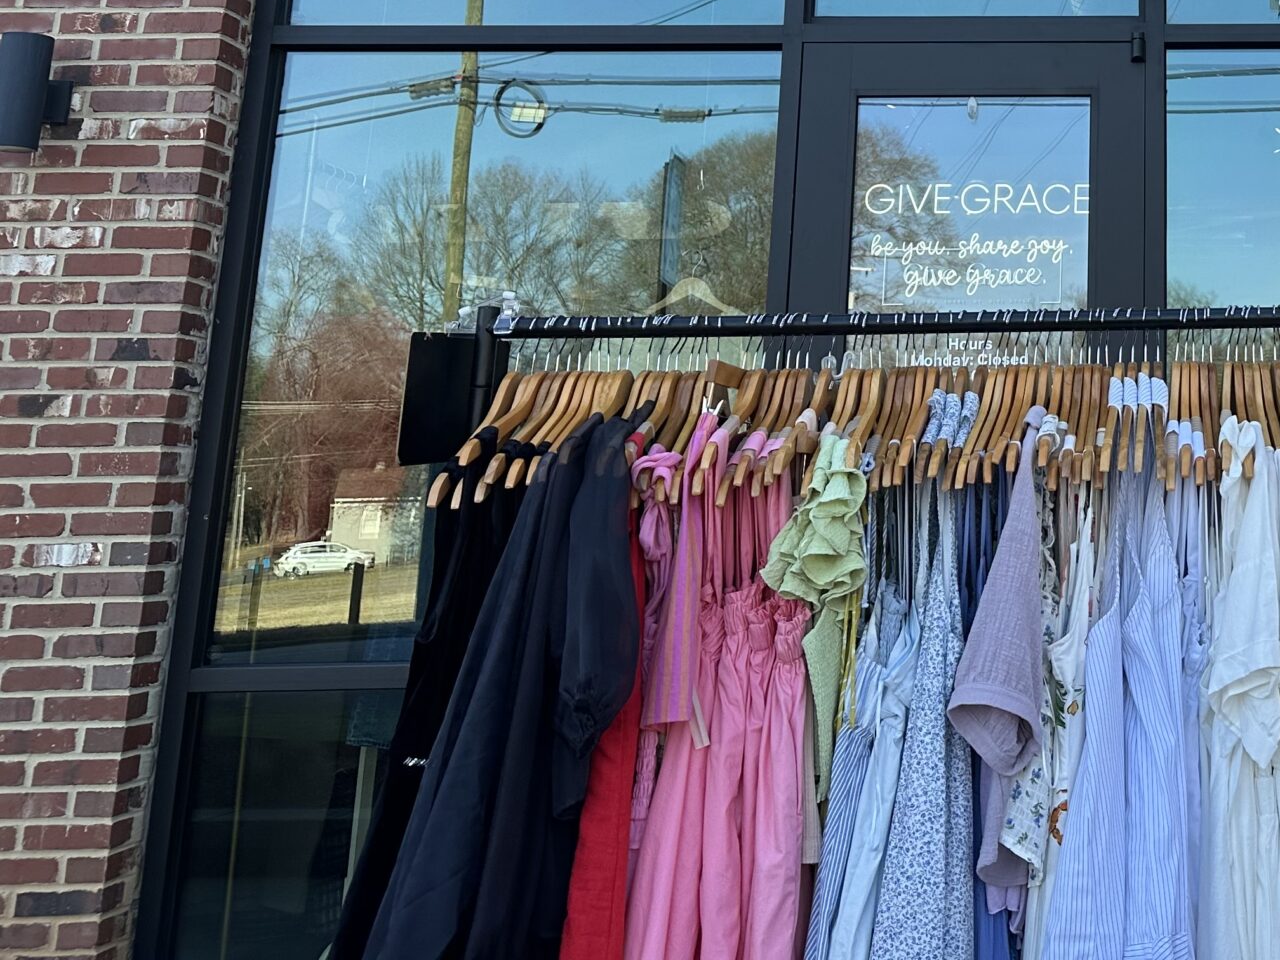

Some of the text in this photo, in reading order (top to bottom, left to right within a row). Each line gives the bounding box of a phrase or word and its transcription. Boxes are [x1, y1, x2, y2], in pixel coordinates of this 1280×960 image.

[864, 182, 1090, 215] GIVE GRACE
[870, 233, 897, 256] be
[958, 232, 1024, 259] share
[903, 266, 961, 297] give
[948, 337, 994, 351] Hours
[910, 353, 1030, 367] Monday: Closed
